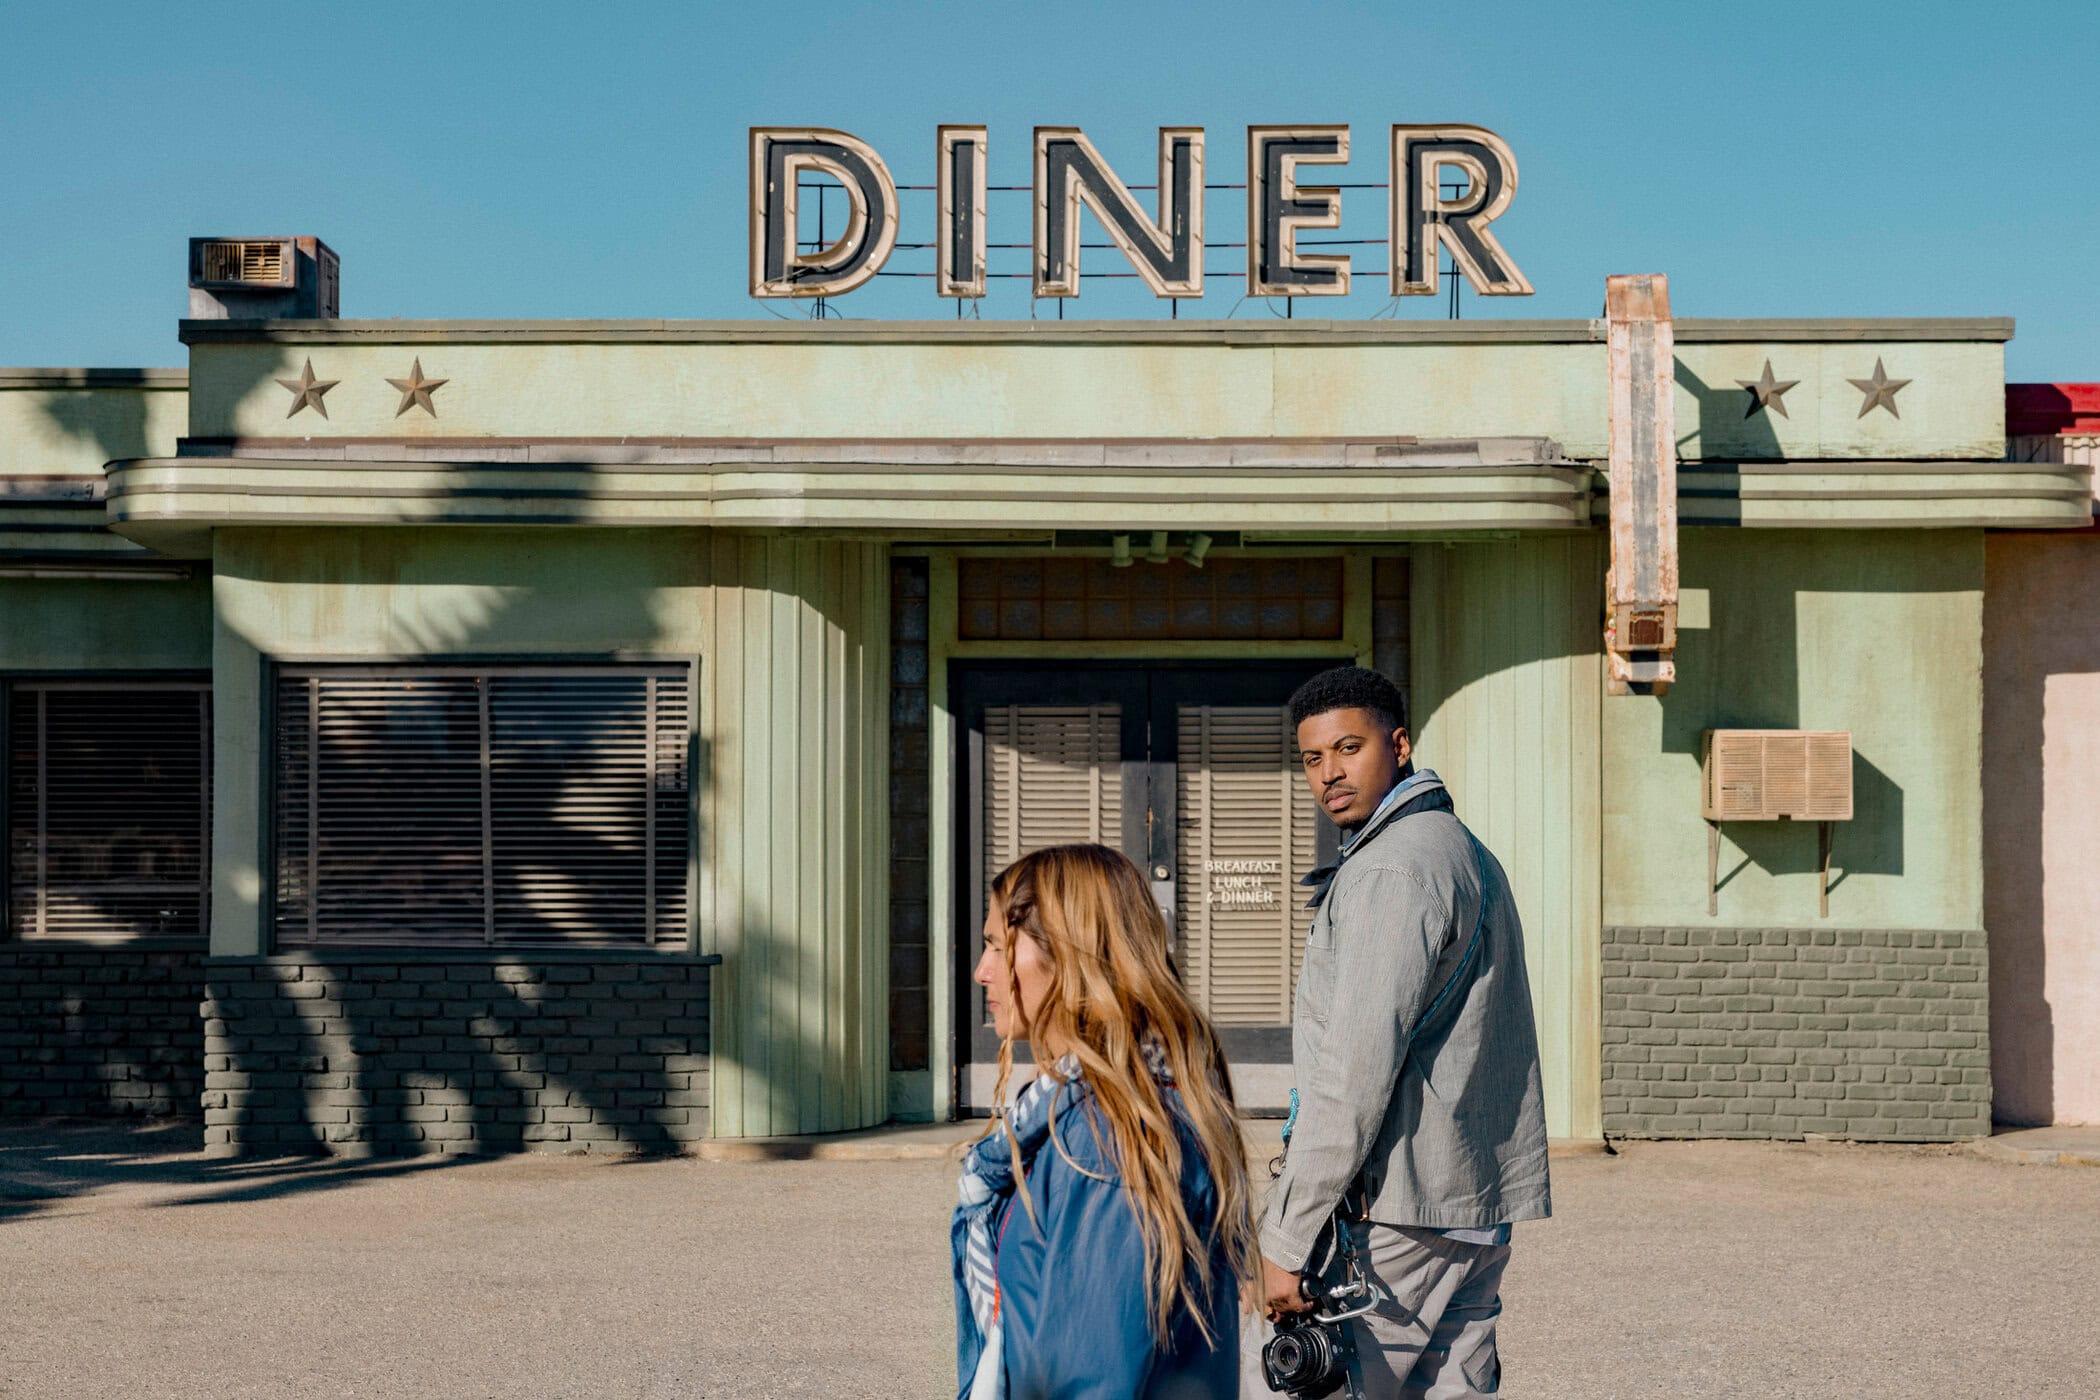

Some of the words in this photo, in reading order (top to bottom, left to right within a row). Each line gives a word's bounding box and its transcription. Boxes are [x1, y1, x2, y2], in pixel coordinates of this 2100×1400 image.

[749, 124, 1535, 297] DINER
[1204, 860, 1279, 873] BREAKFAST
[1215, 876, 1262, 889] LUNCH
[1206, 891, 1214, 904] &
[1221, 890, 1273, 904] DINNER
